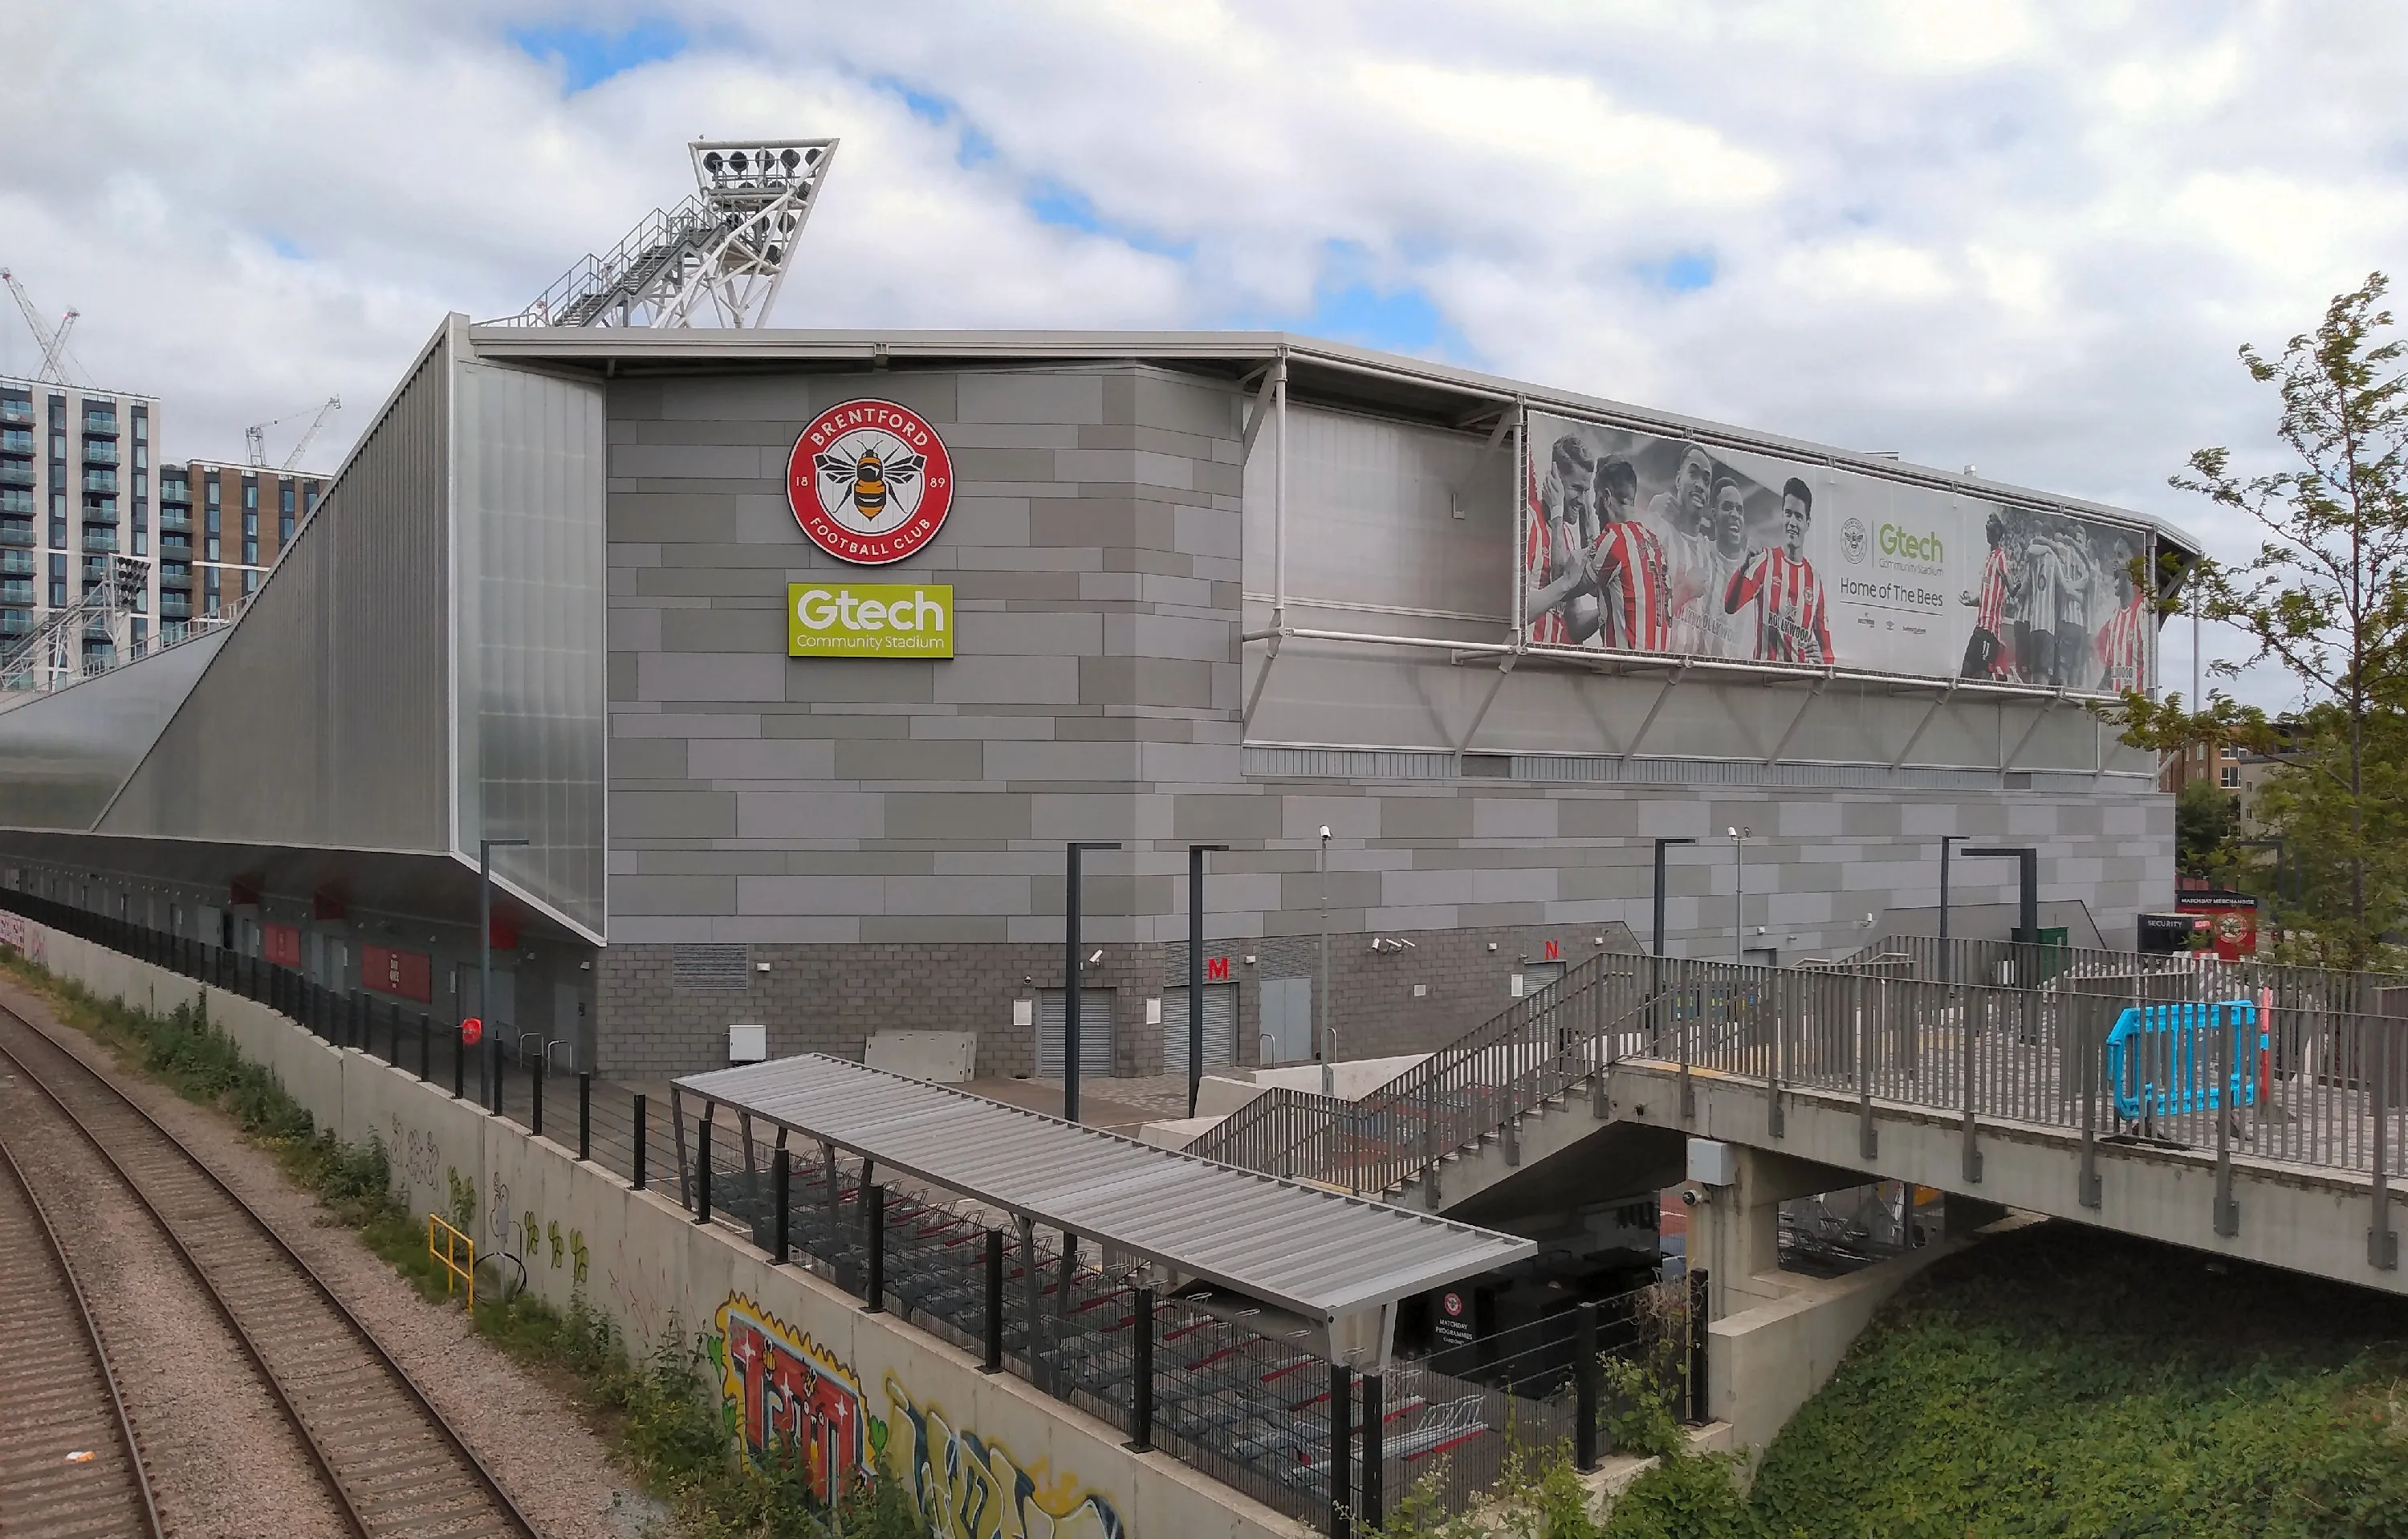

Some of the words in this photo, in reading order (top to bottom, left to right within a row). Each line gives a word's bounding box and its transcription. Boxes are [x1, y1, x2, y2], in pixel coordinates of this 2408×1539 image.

[811, 408, 928, 446] BRENTFORD
[795, 476, 808, 487] 18
[929, 477, 946, 488] 89
[810, 517, 889, 556] FOOTBALL
[894, 519, 931, 550] CLUB
[1879, 523, 1943, 563] Gtech
[1841, 577, 1877, 598] Home
[1879, 583, 1891, 599] of
[1893, 585, 1915, 603] The
[1918, 588, 1943, 607] Bees
[797, 589, 944, 631] Gtech
[797, 634, 883, 650] Community
[885, 635, 944, 649] Stadium
[2148, 920, 2182, 928] SECURITY
[1545, 939, 1558, 960] N
[1208, 957, 1229, 980] M
[1435, 1325, 1473, 1340] PROGRAMMES
[1439, 1318, 1468, 1329] MATCHDAY
